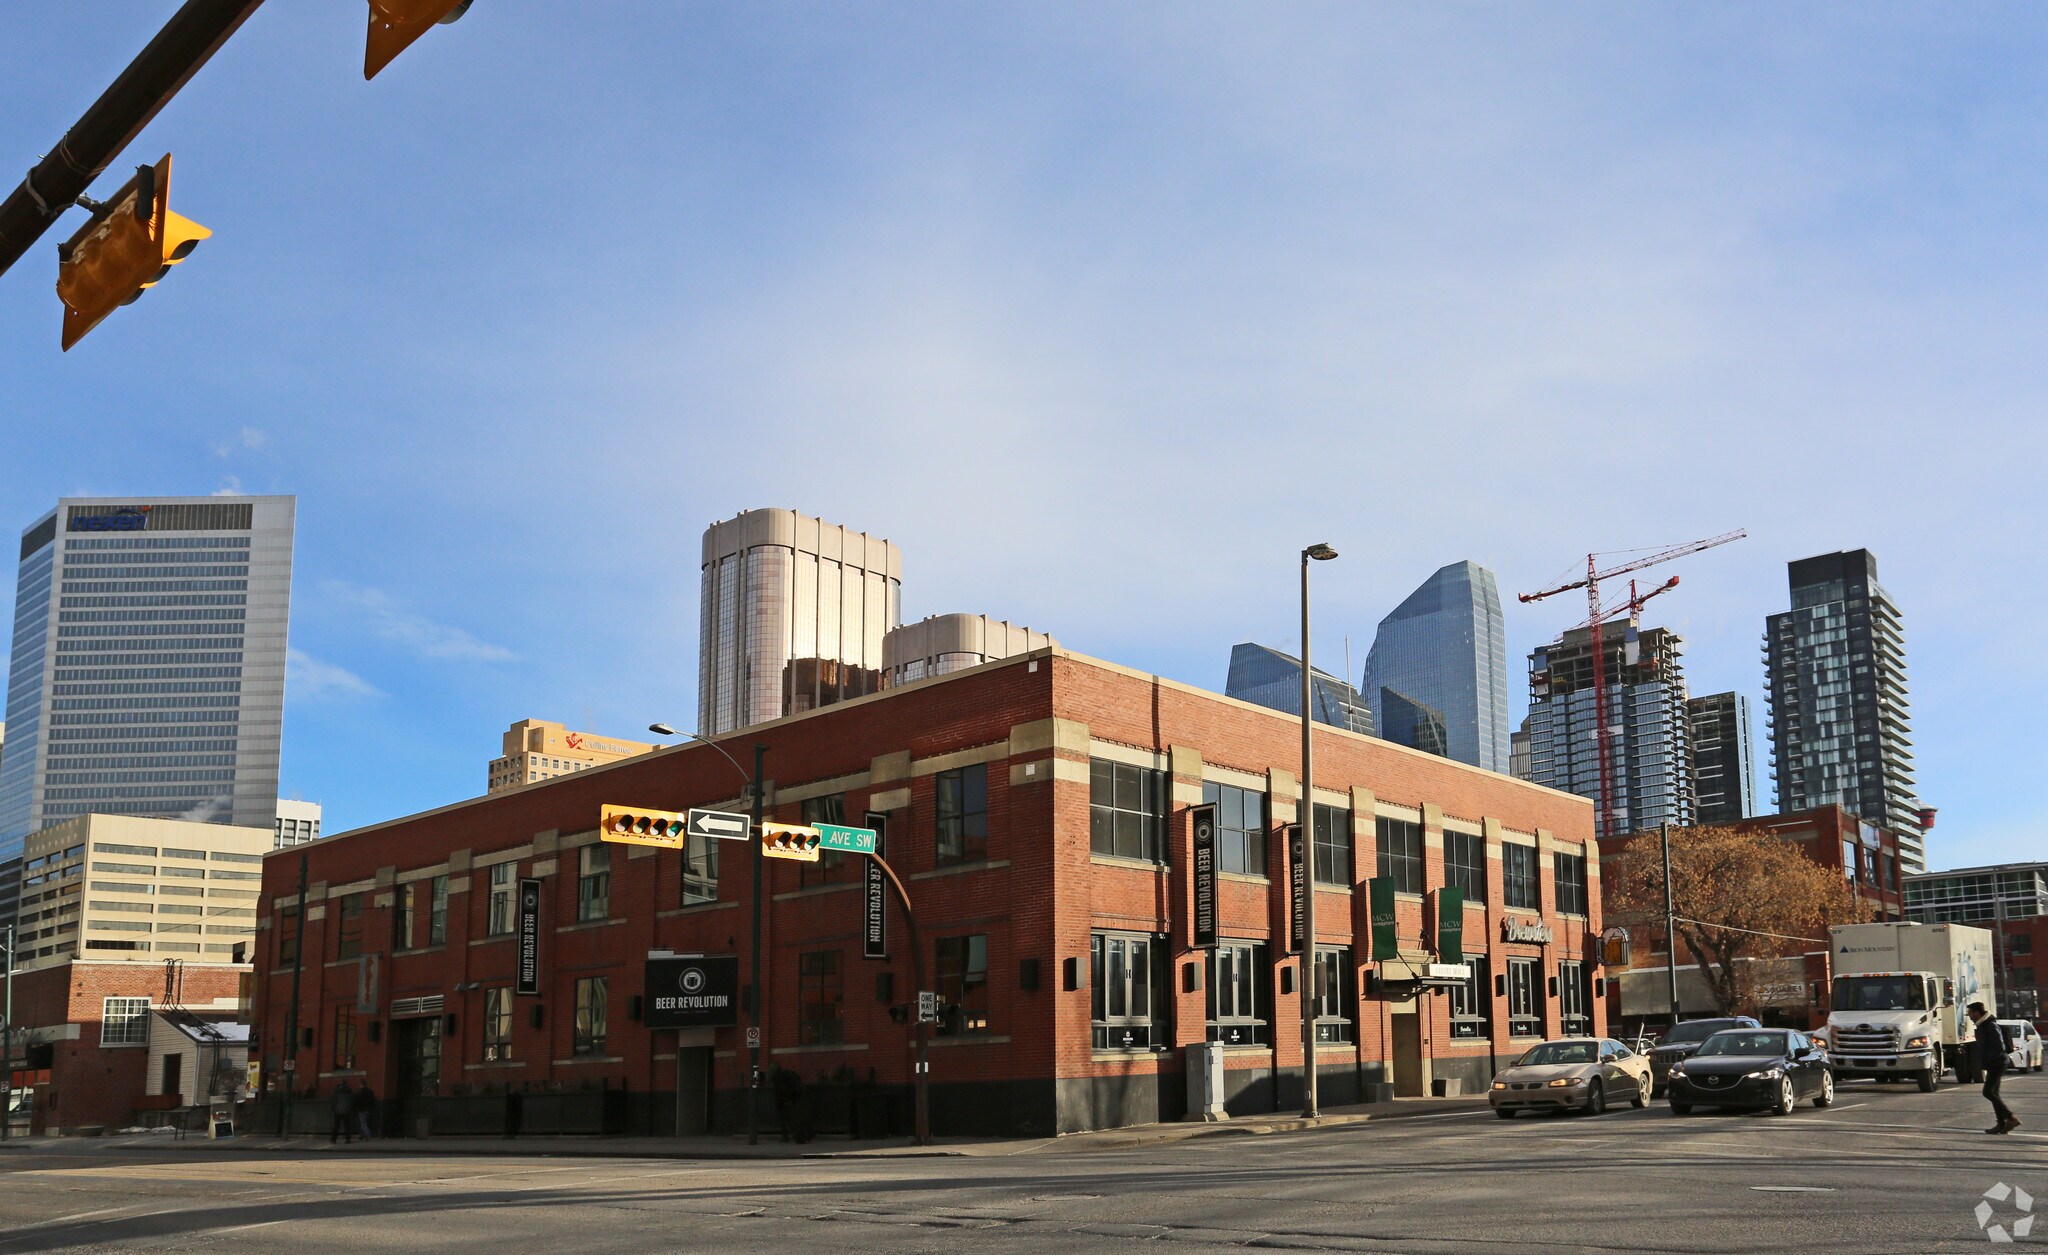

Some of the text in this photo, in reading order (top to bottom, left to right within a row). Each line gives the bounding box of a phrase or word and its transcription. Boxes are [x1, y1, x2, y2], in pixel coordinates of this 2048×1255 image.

[71, 514, 147, 531] nexen
[829, 831, 851, 846] AVE
[856, 833, 872, 848] SW
[1198, 848, 1212, 932] BEER REVOLUTION
[869, 883, 882, 942] REVOLUTION
[1372, 912, 1394, 921] MCW
[1440, 920, 1462, 928] MCW
[522, 913, 535, 982] BEER REVOLUTION
[656, 995, 728, 1010] BEER REVOLUTION
[920, 994, 933, 1002] ONE
[920, 1002, 933, 1010] WAY
